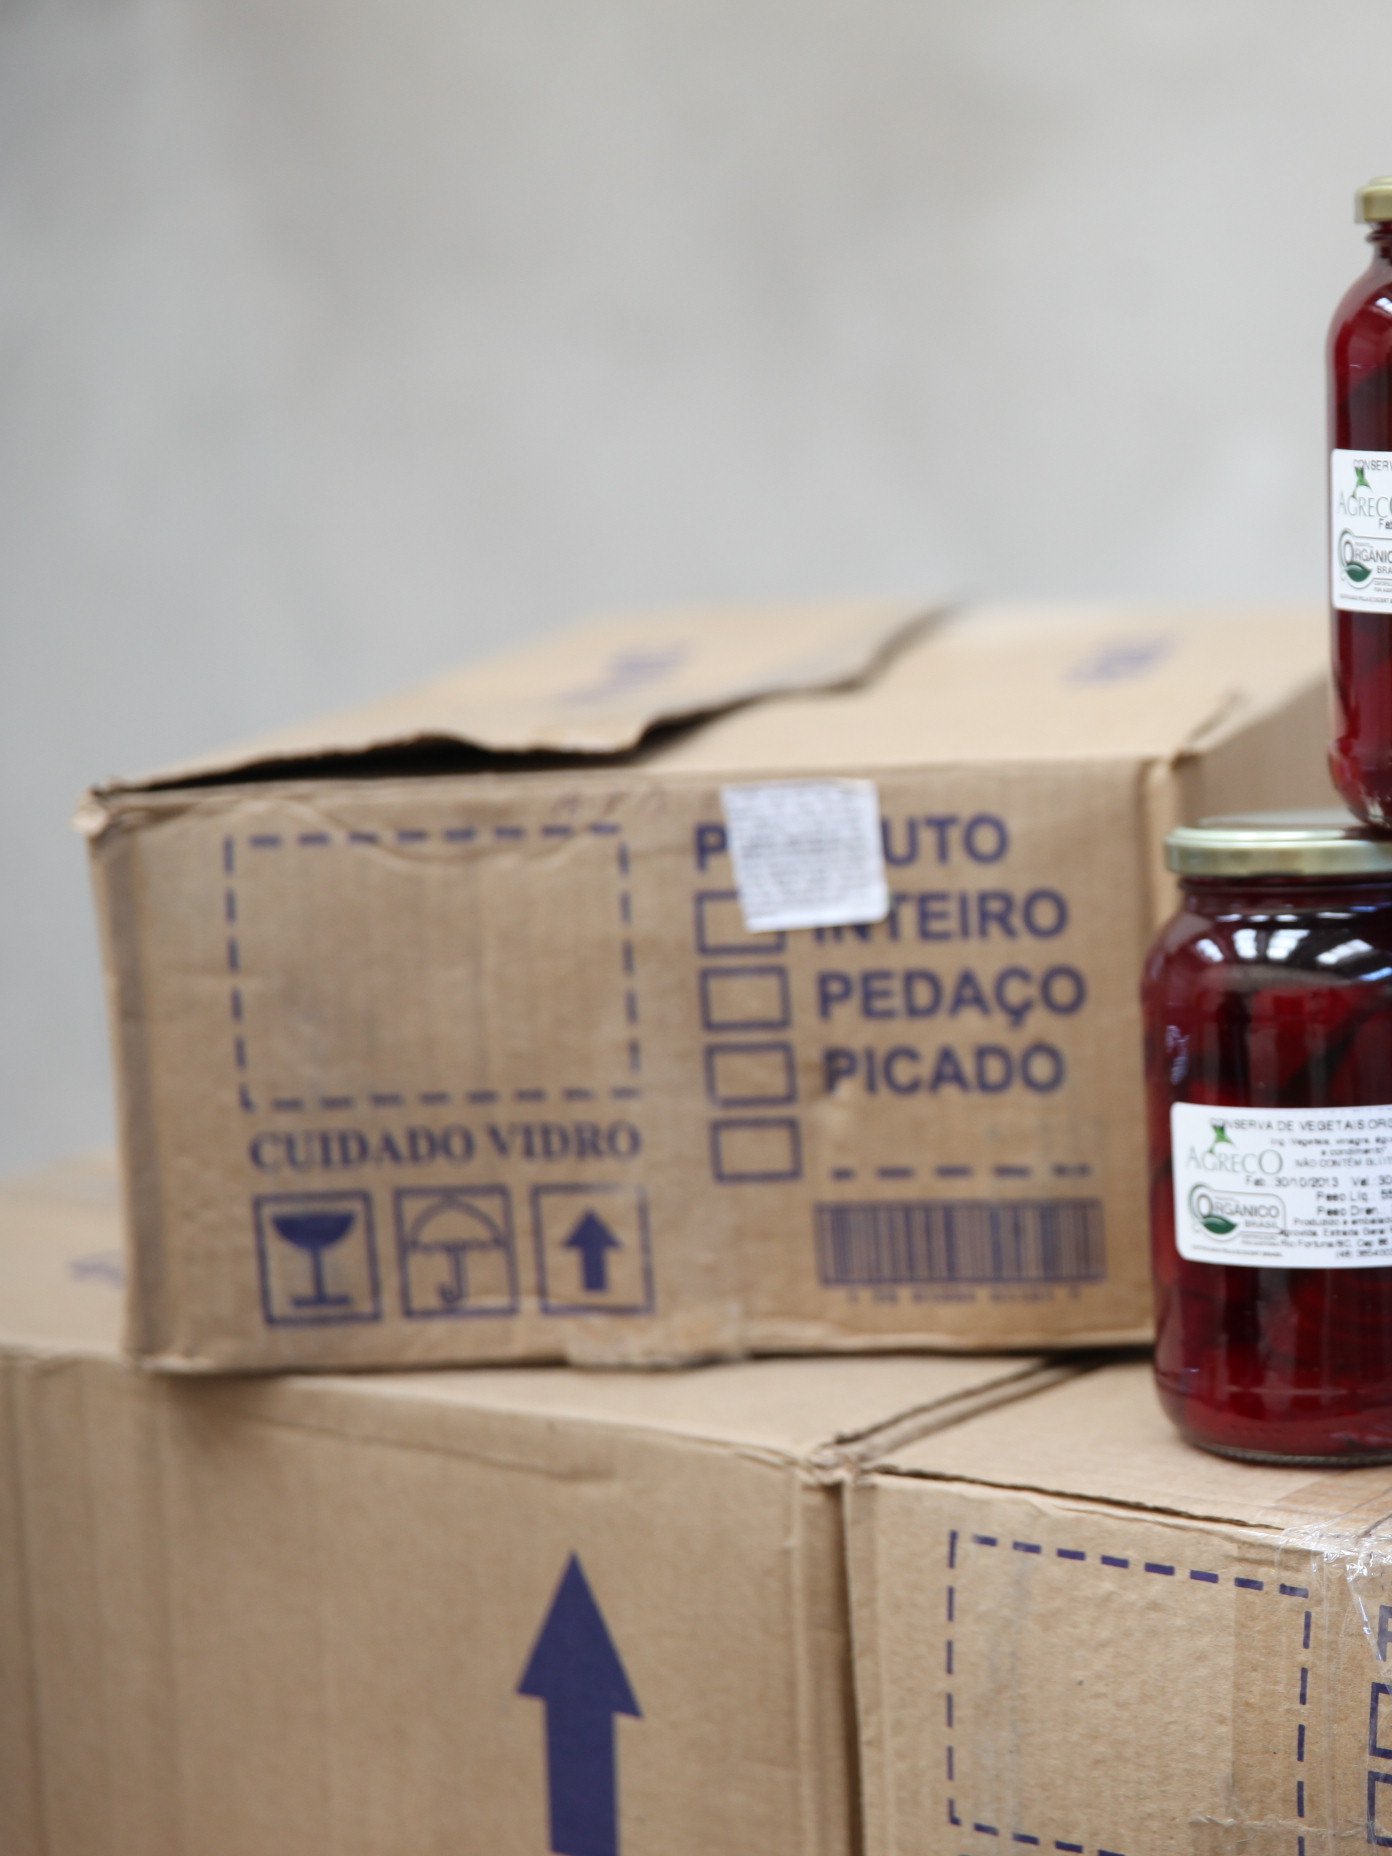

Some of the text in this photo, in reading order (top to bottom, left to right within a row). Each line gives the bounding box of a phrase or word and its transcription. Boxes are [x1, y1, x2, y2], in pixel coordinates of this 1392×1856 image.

[694, 813, 1011, 872] PUTO
[817, 965, 1088, 1029] PEDAÇO
[823, 1041, 1066, 1094] PICADO
[249, 1120, 641, 1169] CUIDADO VIDRO
[1186, 1145, 1283, 1175] AGRECO
